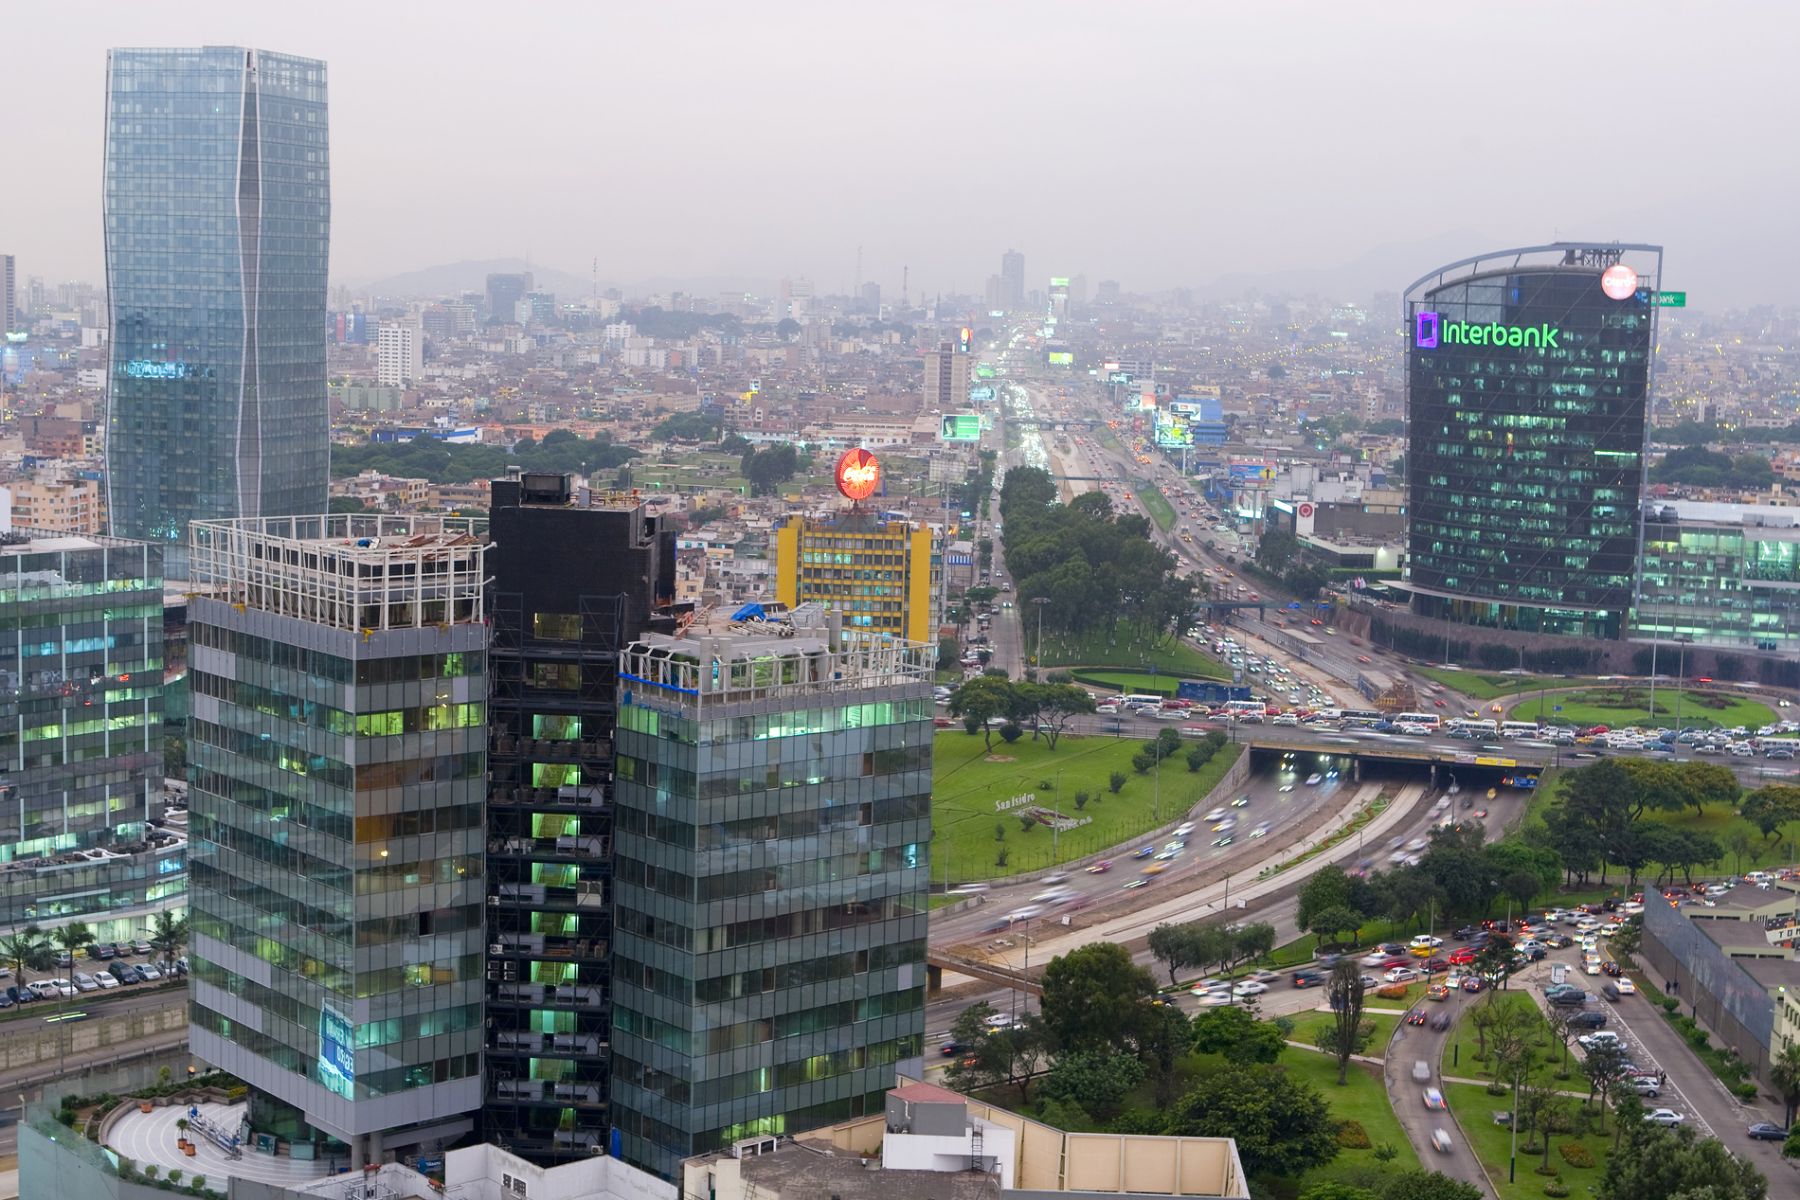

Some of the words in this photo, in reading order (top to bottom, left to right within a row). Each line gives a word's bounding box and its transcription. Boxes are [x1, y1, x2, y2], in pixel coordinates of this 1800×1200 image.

[1442, 319, 1559, 349] Interbank
[995, 800, 1010, 812] San
[1011, 793, 1035, 807] Isidro
